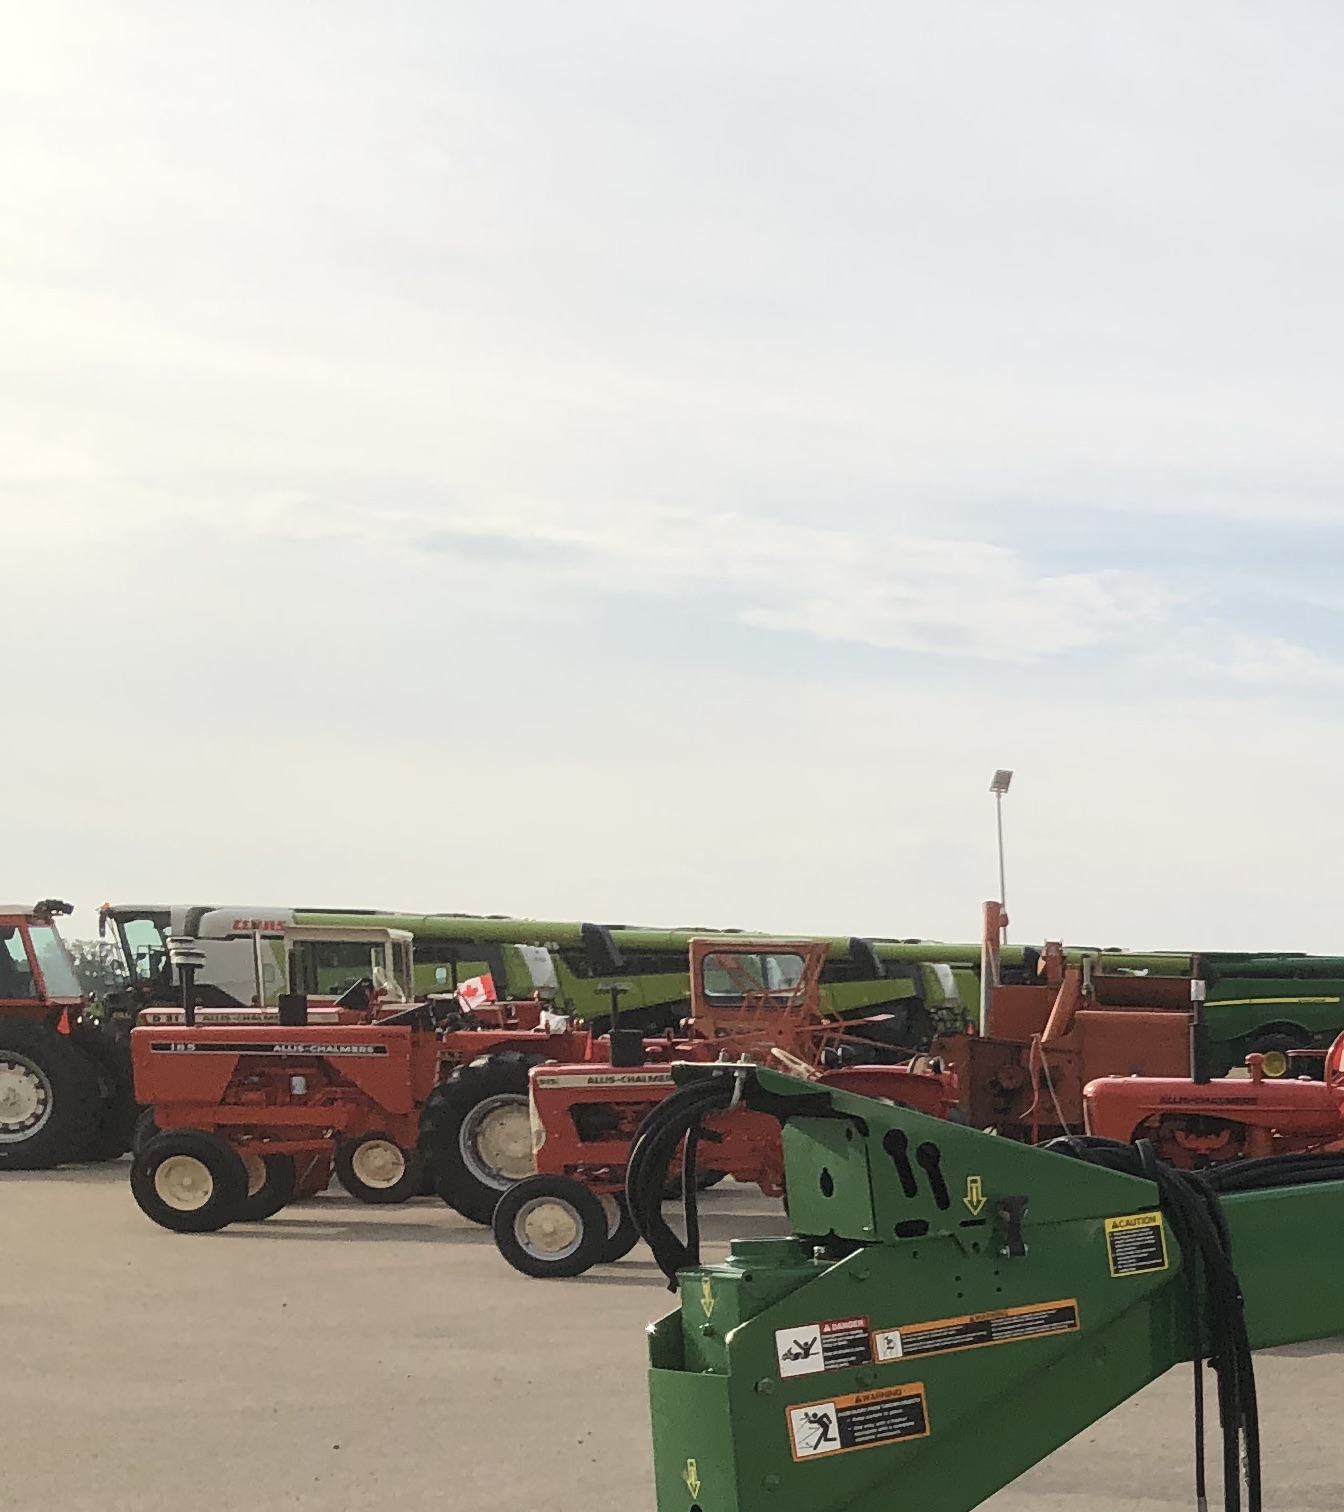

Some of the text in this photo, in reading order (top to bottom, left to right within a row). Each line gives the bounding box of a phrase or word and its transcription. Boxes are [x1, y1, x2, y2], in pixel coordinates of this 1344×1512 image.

[273, 1044, 375, 1054] ALLIS-CHALMERS
[1119, 1215, 1157, 1227] CAUTION
[861, 1388, 903, 1403] WARNING
